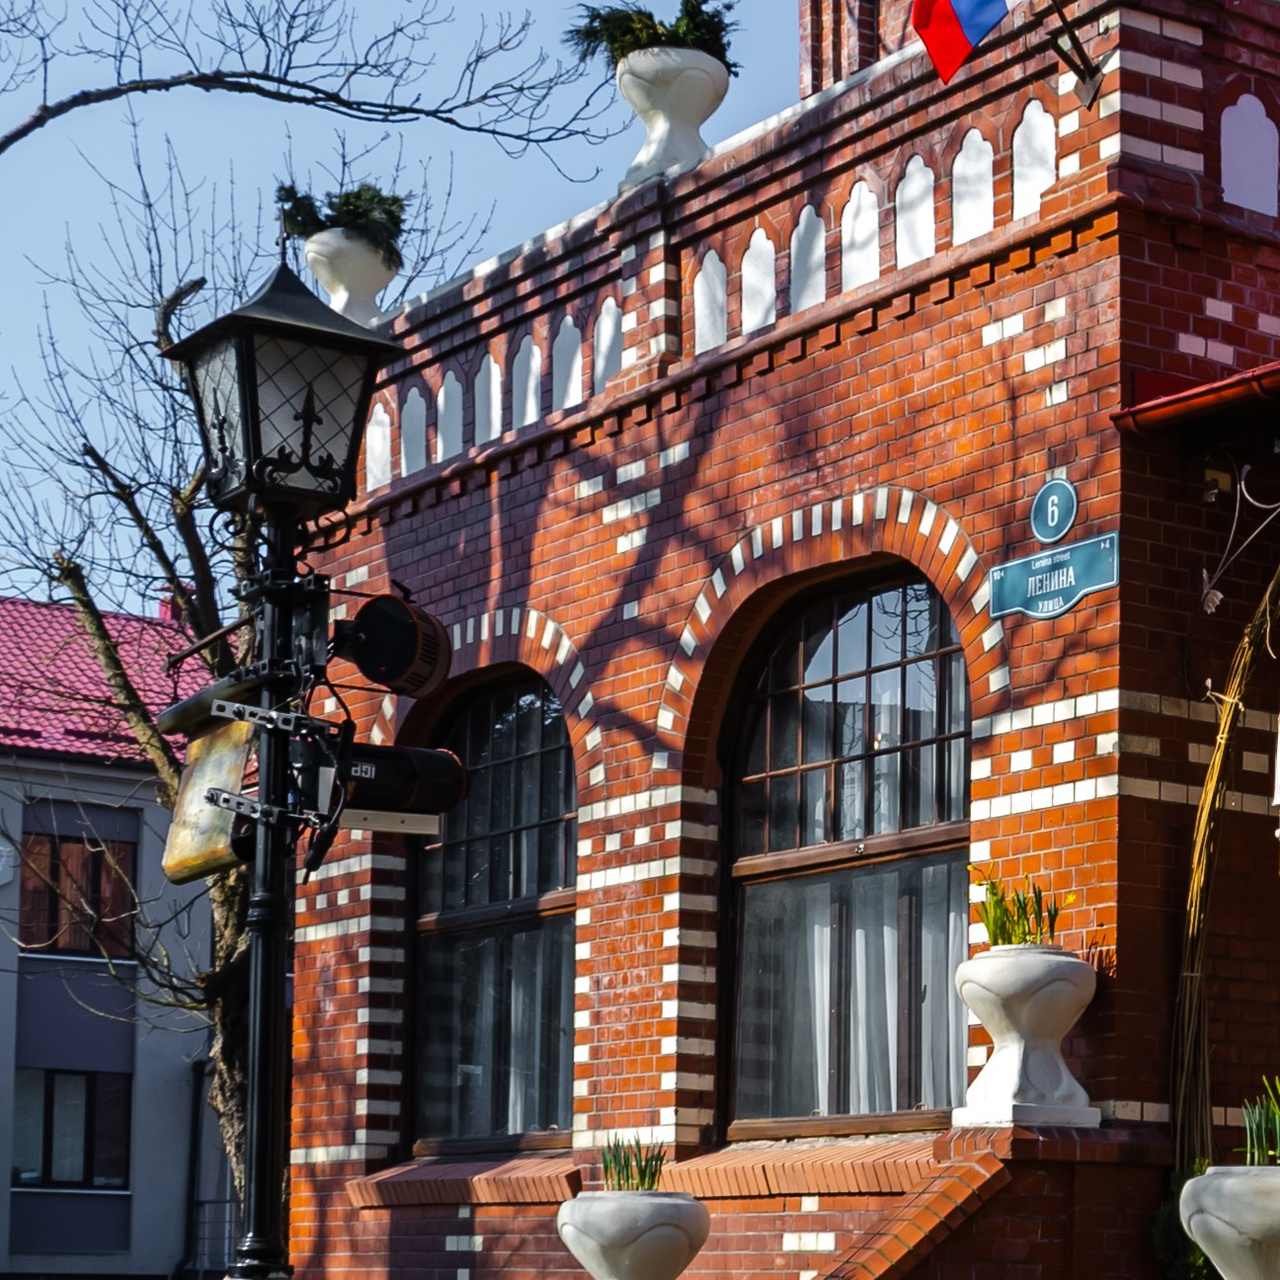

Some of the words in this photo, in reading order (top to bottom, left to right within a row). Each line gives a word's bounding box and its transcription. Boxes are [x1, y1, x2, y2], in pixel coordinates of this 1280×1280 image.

[1047, 495, 1059, 527] 6
[1027, 566, 1075, 597] ЛЕНИНА
[1038, 596, 1064, 612] УЛИЦА
